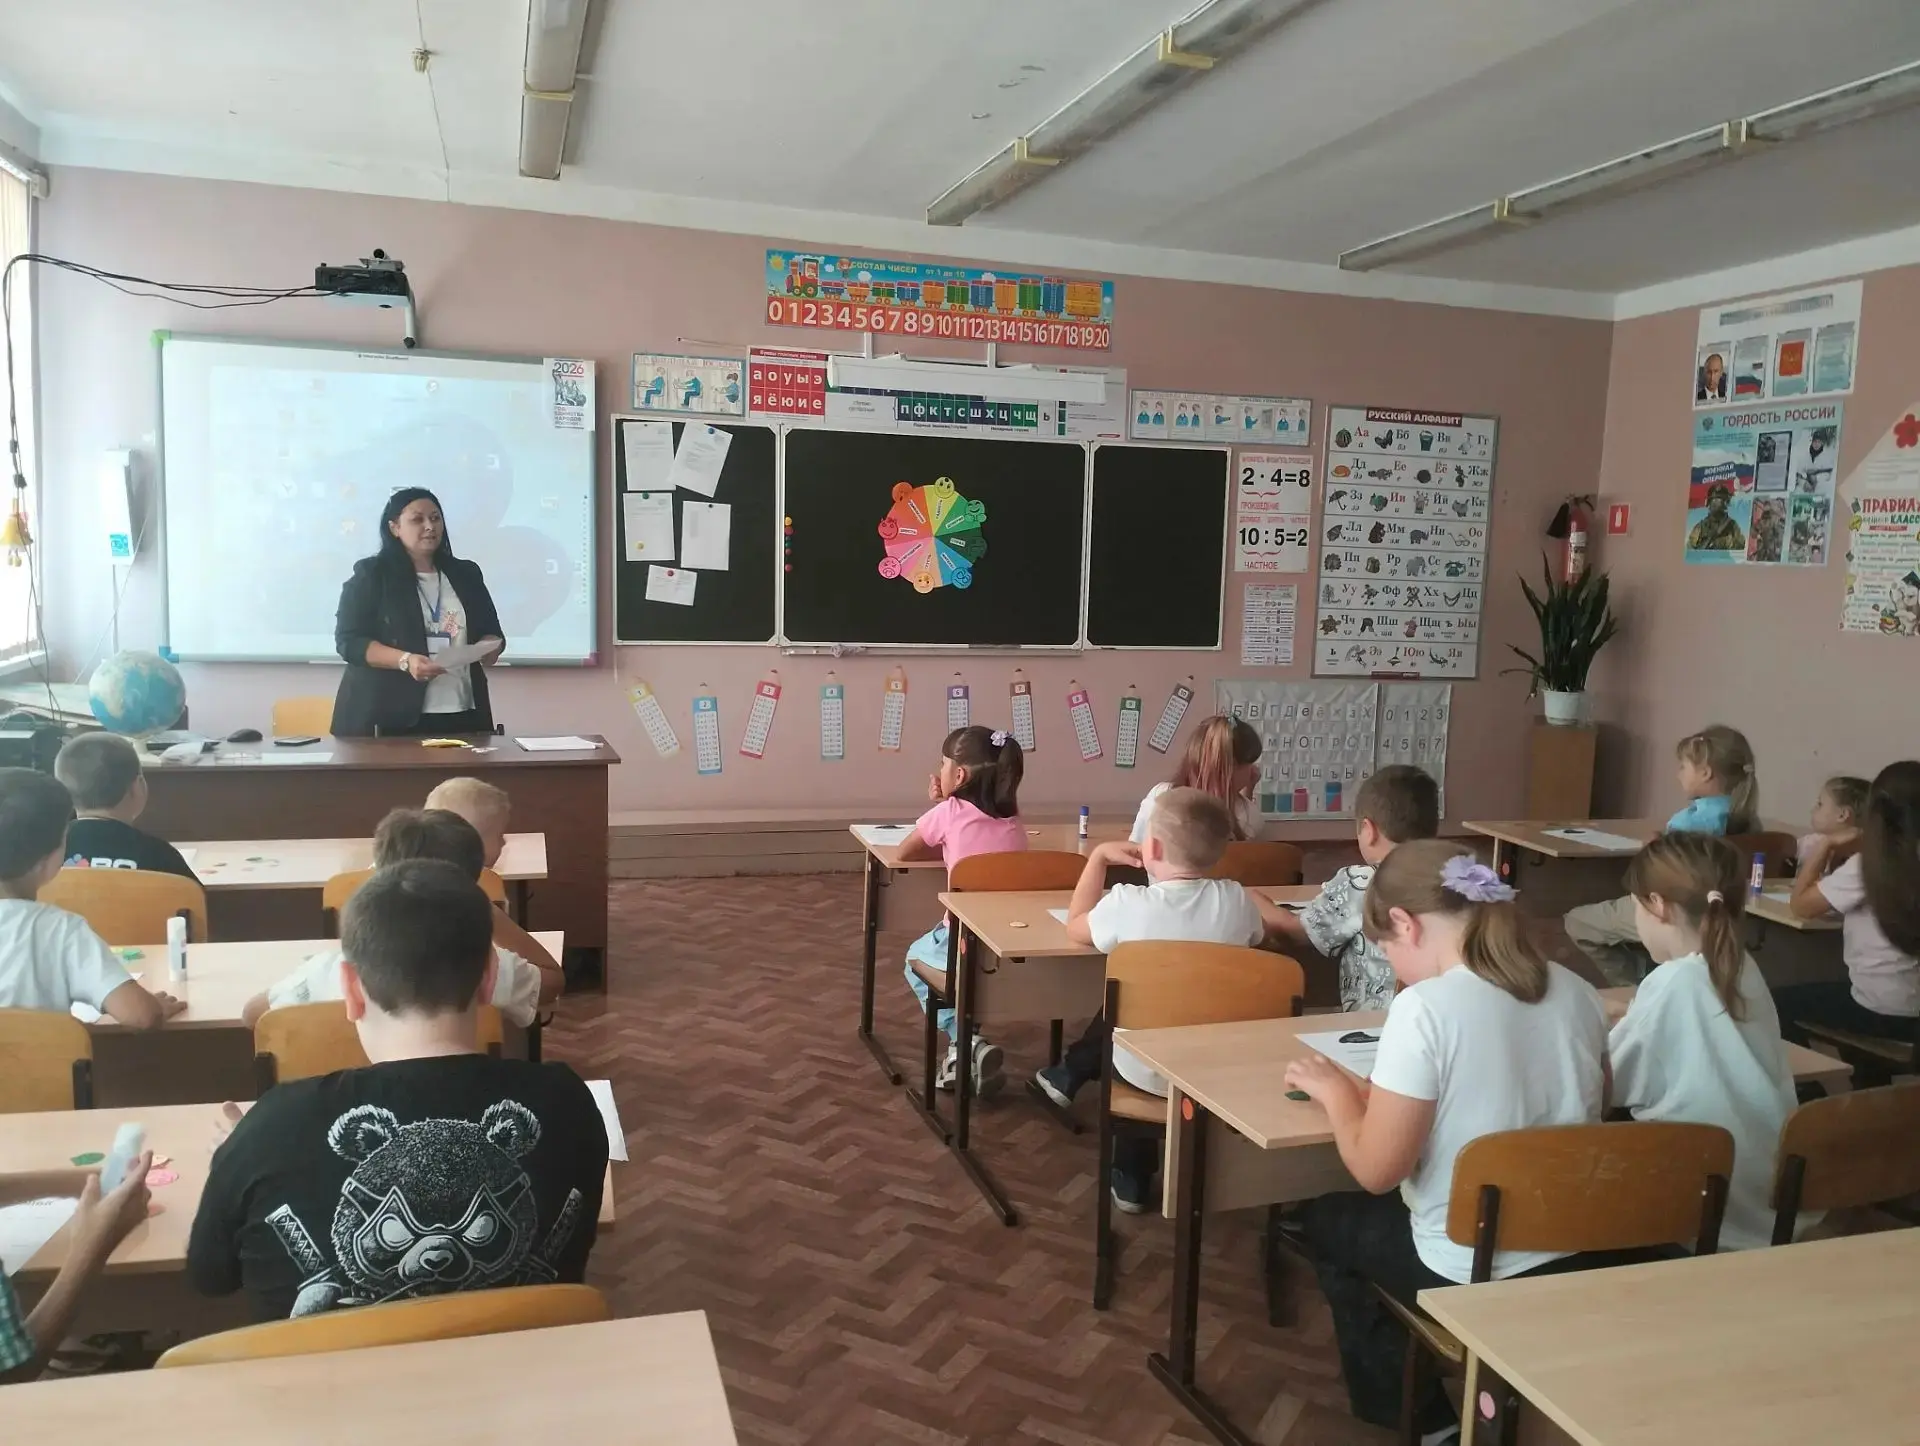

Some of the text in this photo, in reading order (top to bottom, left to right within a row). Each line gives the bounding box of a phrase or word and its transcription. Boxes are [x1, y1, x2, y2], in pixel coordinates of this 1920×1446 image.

[851, 261, 886, 271] СОСТАВ
[888, 264, 917, 274] ЧИСЕЛ
[768, 300, 1110, 348] 0 1 2 3 4 5 6 7 8 9 10 11 12 13 14 15 16 17 18 19 20
[554, 362, 584, 374] 2026
[753, 370, 822, 385] а о у ы э
[753, 393, 822, 409] я ё ю и е
[900, 402, 1050, 422] п ф к т с ш х ц ч щ ь
[1368, 410, 1461, 424] РУССКИЙ АЛФАВИТ
[1722, 406, 1836, 428] ГОРДОСТЬ РОССИИ
[1354, 426, 1370, 438] Аа
[1396, 428, 1410, 440] Бб
[1437, 432, 1450, 442] Вв
[1351, 458, 1366, 470] Дд
[1394, 460, 1406, 471] Ее
[1704, 462, 1734, 476] ВОЕННАЯ
[1242, 468, 1254, 486] 2
[1468, 466, 1488, 476] Жж
[1702, 472, 1736, 483] ОПЕРАЦИЯ
[1350, 490, 1362, 500] Зз
[1472, 496, 1485, 507] Кк
[1862, 498, 1920, 513] ПРАВИЛ
[1346, 522, 1362, 532] Лл
[1387, 523, 1406, 534] Мм
[1430, 526, 1444, 536] Нн
[1469, 527, 1482, 538] Оо
[1240, 528, 1260, 546] 10
[1387, 554, 1400, 564] Рр
[1428, 556, 1440, 566] Сс
[1468, 557, 1481, 567] Тт
[1244, 562, 1278, 570] ЧАСТНОЕ
[1342, 584, 1356, 596] Уу
[1382, 585, 1400, 598] Фф
[1424, 586, 1439, 596] Хх
[1462, 588, 1478, 599] Цц
[1340, 615, 1355, 625] Чч
[1377, 616, 1398, 626] Шш
[1420, 616, 1440, 628] Щщ
[1458, 618, 1476, 628] Ыы
[1404, 646, 1424, 657] Юю
[1234, 705, 1242, 716] Б
[1250, 706, 1258, 716] В
[1284, 706, 1294, 718] Д
[1386, 708, 1443, 721] 0 1 2 3
[1382, 738, 1442, 750] 4 5 6 7
